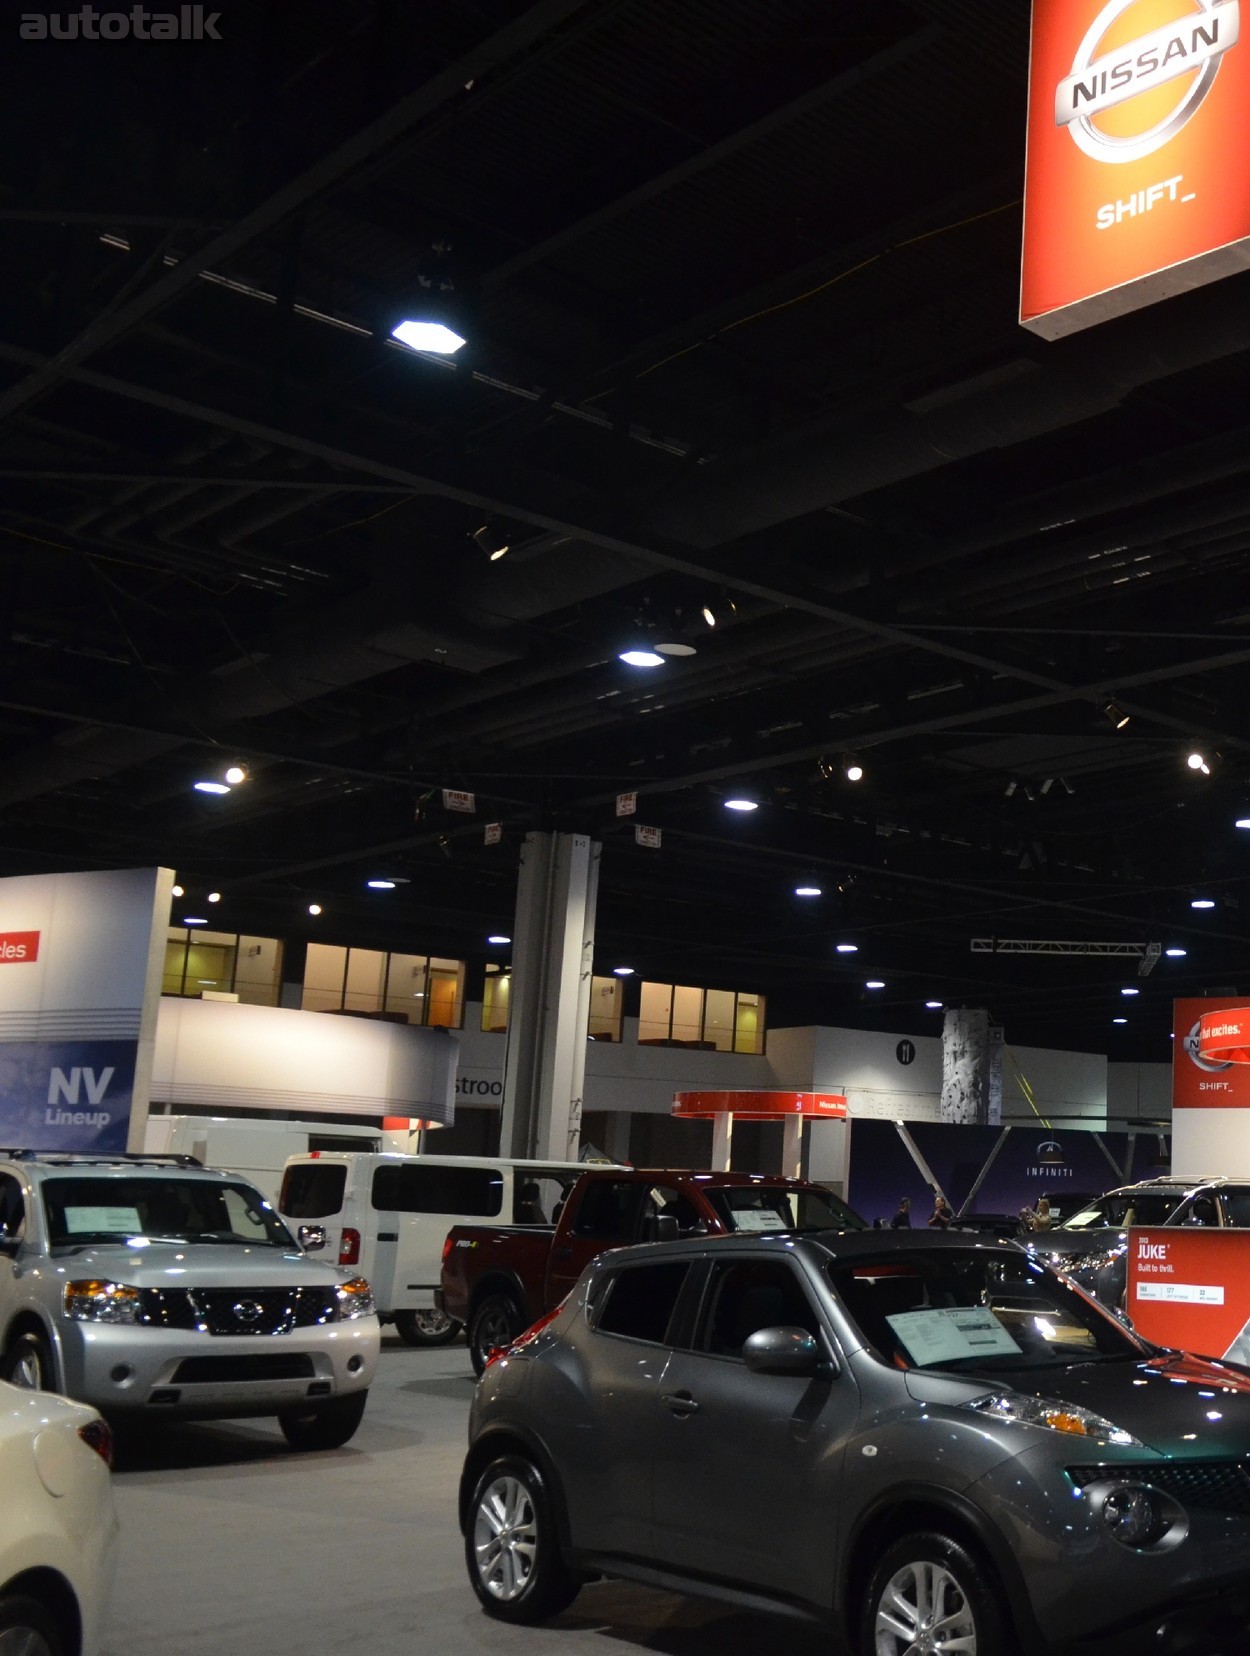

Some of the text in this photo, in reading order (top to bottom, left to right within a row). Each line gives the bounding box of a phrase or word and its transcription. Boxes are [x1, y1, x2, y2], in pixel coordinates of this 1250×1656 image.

[1071, 18, 1219, 109] NISSAN
[448, 792, 469, 801] FIRE
[620, 794, 633, 802] FIRE
[640, 827, 657, 836] FIRE
[0, 941, 27, 958] les
[47, 1067, 115, 1104] NV
[45, 1108, 111, 1129] Lineup
[1026, 1167, 1073, 1177] INFINITI
[1137, 1263, 1174, 1273] Built to thrill.
